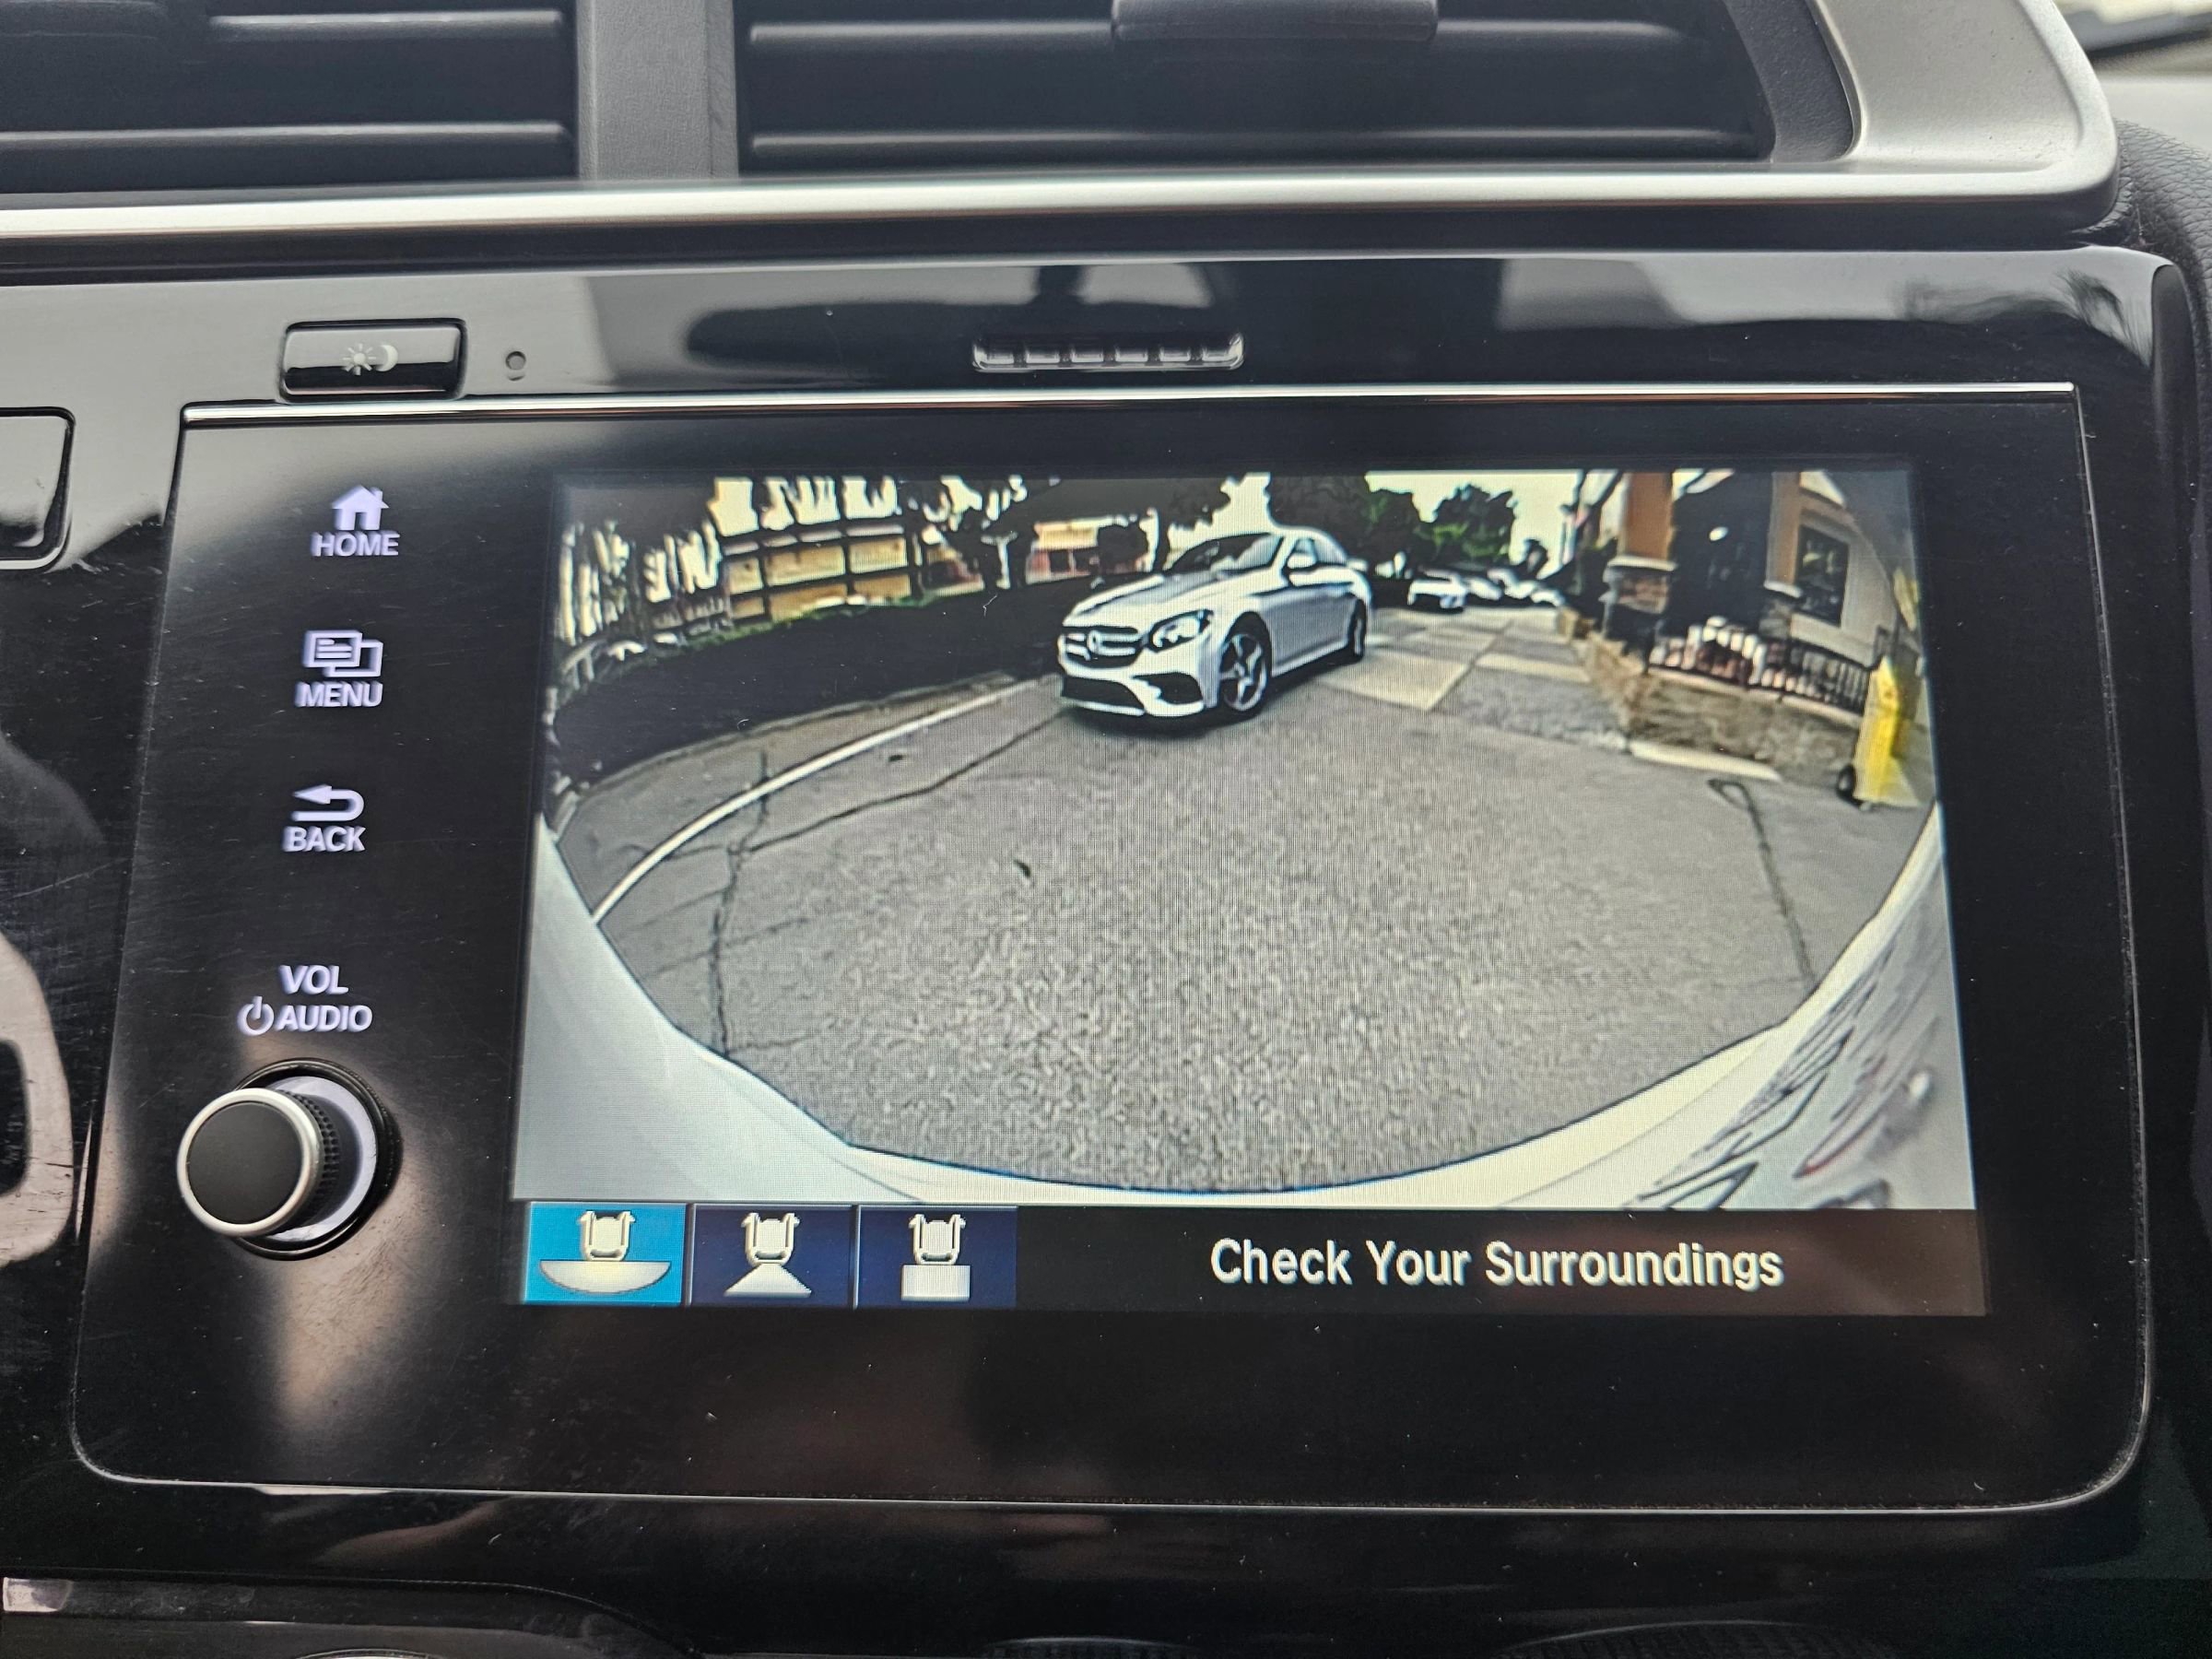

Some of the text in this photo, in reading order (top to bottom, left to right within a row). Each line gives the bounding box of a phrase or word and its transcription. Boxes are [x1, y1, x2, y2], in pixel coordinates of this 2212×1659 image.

[312, 531, 400, 558] HOME
[294, 680, 383, 709] MENU
[281, 826, 366, 852] BACK
[279, 964, 349, 994] VOL
[277, 1003, 373, 1032] AUDIO
[1209, 1237, 1786, 1291] Check Your Surroundings
